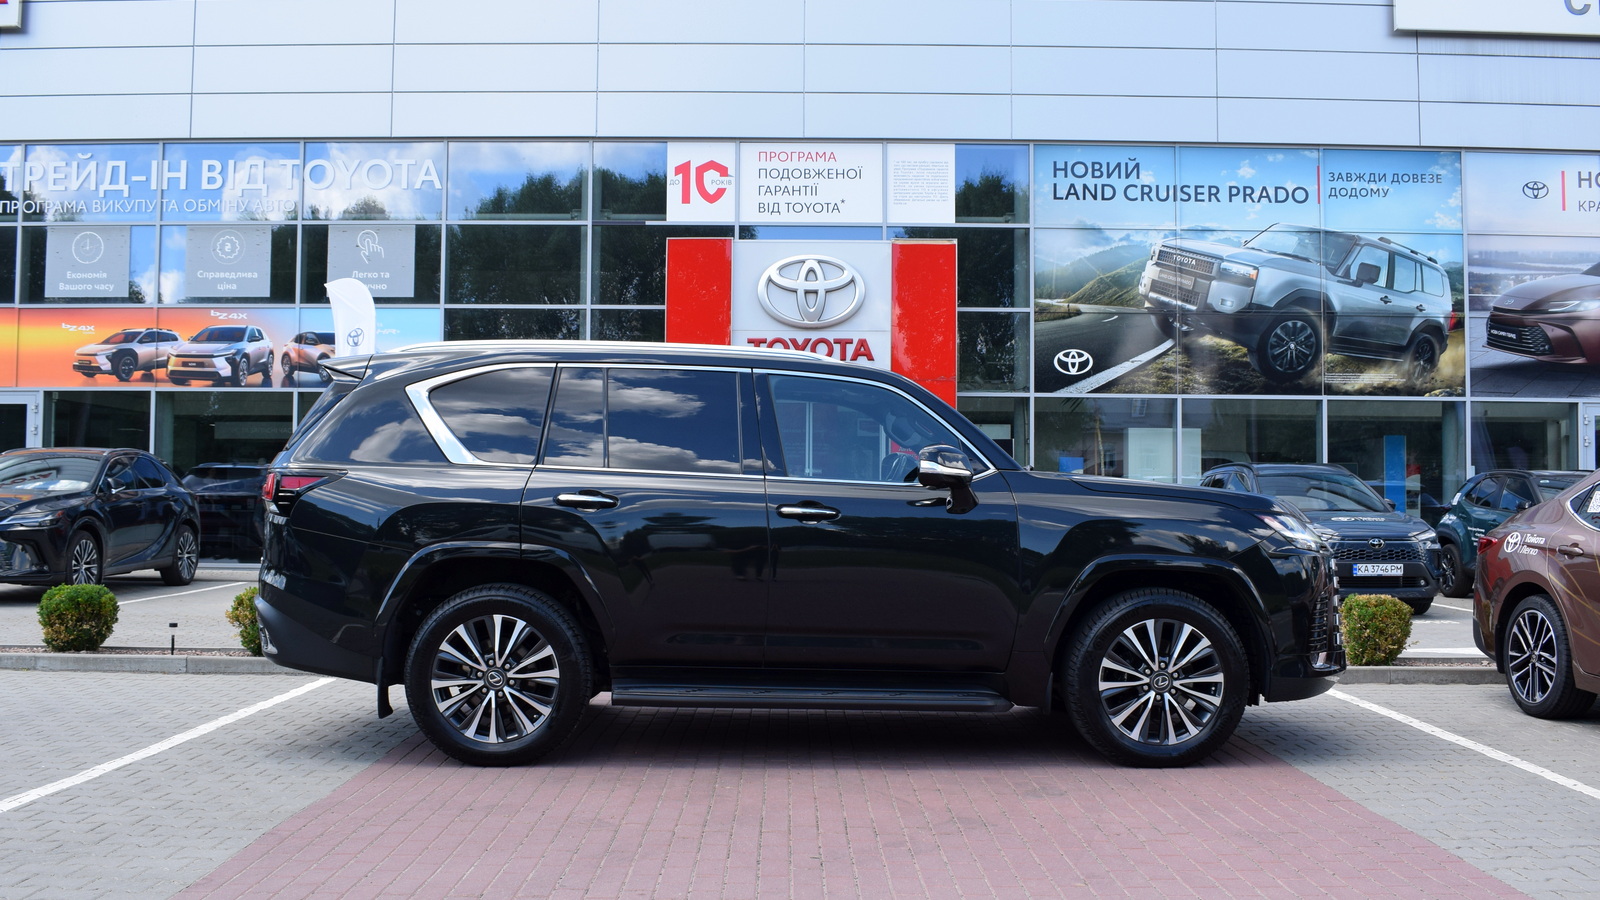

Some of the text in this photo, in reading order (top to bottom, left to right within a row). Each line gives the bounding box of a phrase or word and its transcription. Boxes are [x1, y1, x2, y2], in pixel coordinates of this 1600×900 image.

[758, 151, 837, 162] ПРОГРАМА
[758, 166, 864, 181] ПОДОВЖЕНОЇ
[1053, 157, 1140, 180] НОВИЙ
[0, 152, 443, 198] ТРЕЙД-ІН ВІД TOYOTA
[1328, 172, 1443, 185] ЗАВЖДИ ДОВЕЗЕ
[758, 183, 819, 196] ГАРАНТІЇ
[1053, 183, 1309, 204] LAND CRUISER PRADO
[1328, 187, 1390, 199] ДОДОМУ
[0, 198, 297, 214] ПРОГРАМА ВИКУПУ ТА ОБМІНУ АВТО
[758, 202, 781, 215] ВІД
[1173, 254, 1196, 265] TOYOTA
[66, 271, 107, 279] Економія
[197, 270, 258, 280] Справедлива
[352, 270, 378, 278] Легко
[59, 283, 114, 292] Вашого часу
[217, 282, 237, 291] ціна
[1524, 533, 1546, 545] Тойота
[1357, 565, 1370, 573] KA
[1370, 565, 1389, 573] 3746
